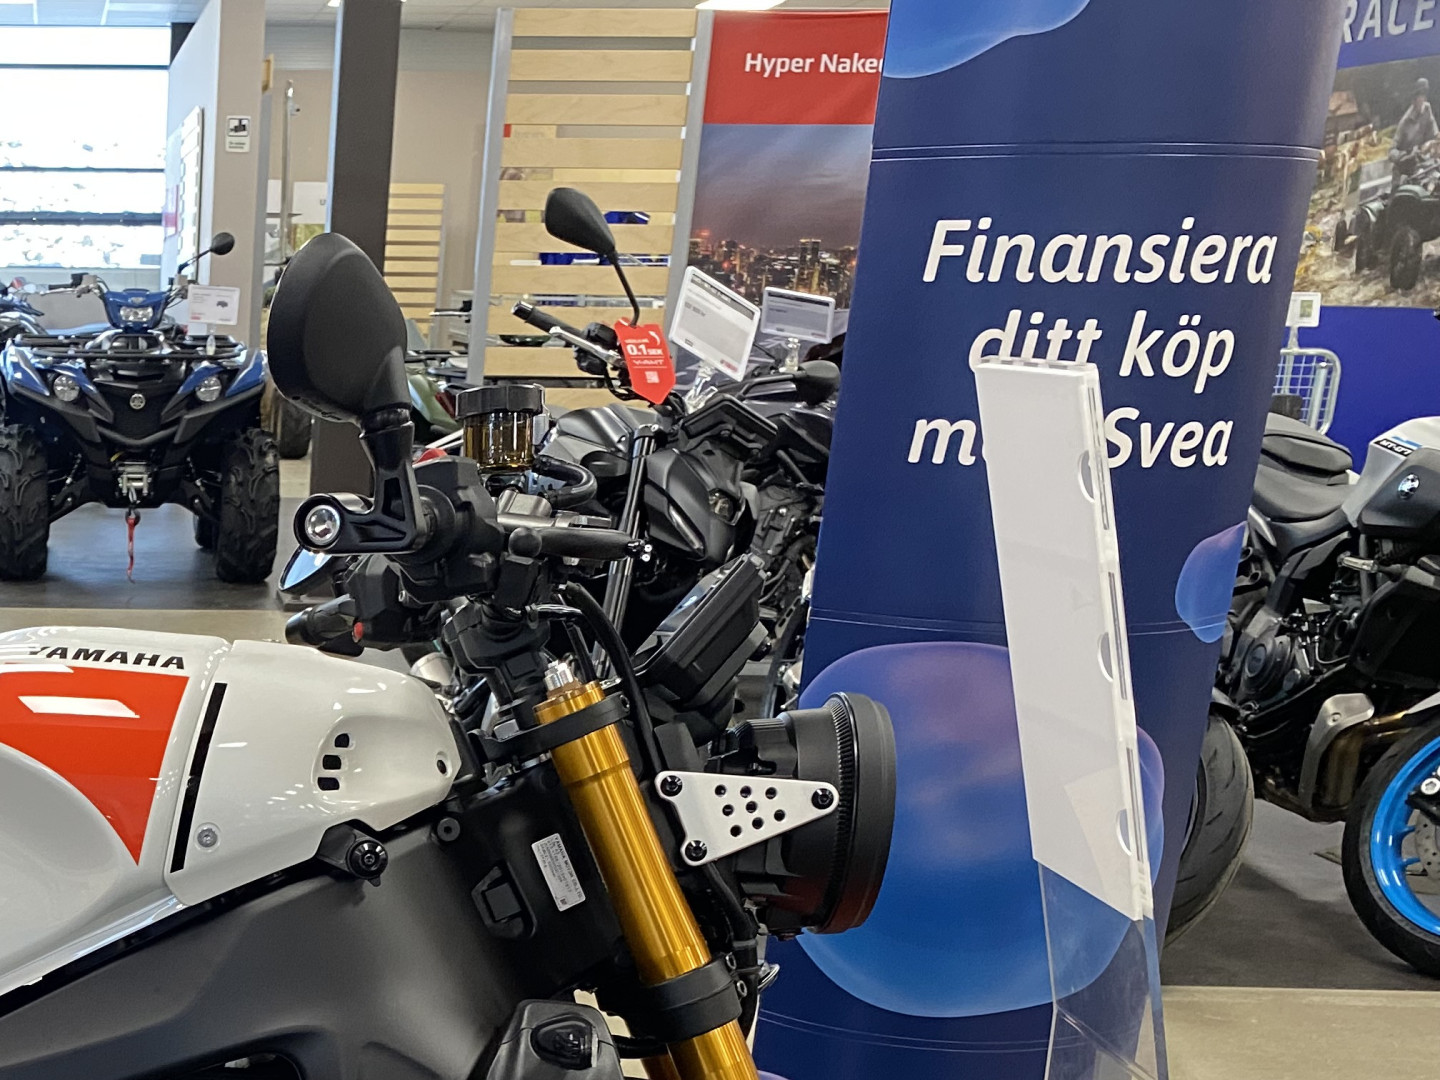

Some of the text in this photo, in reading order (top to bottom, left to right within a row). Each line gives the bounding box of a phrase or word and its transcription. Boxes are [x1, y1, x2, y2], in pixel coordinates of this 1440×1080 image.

[745, 53, 815, 78] Hyper
[922, 216, 1278, 284] Finansiera
[968, 309, 1236, 394] ditt köp
[1105, 406, 1234, 469] Svea
[29, 646, 185, 670] YAMAHA
